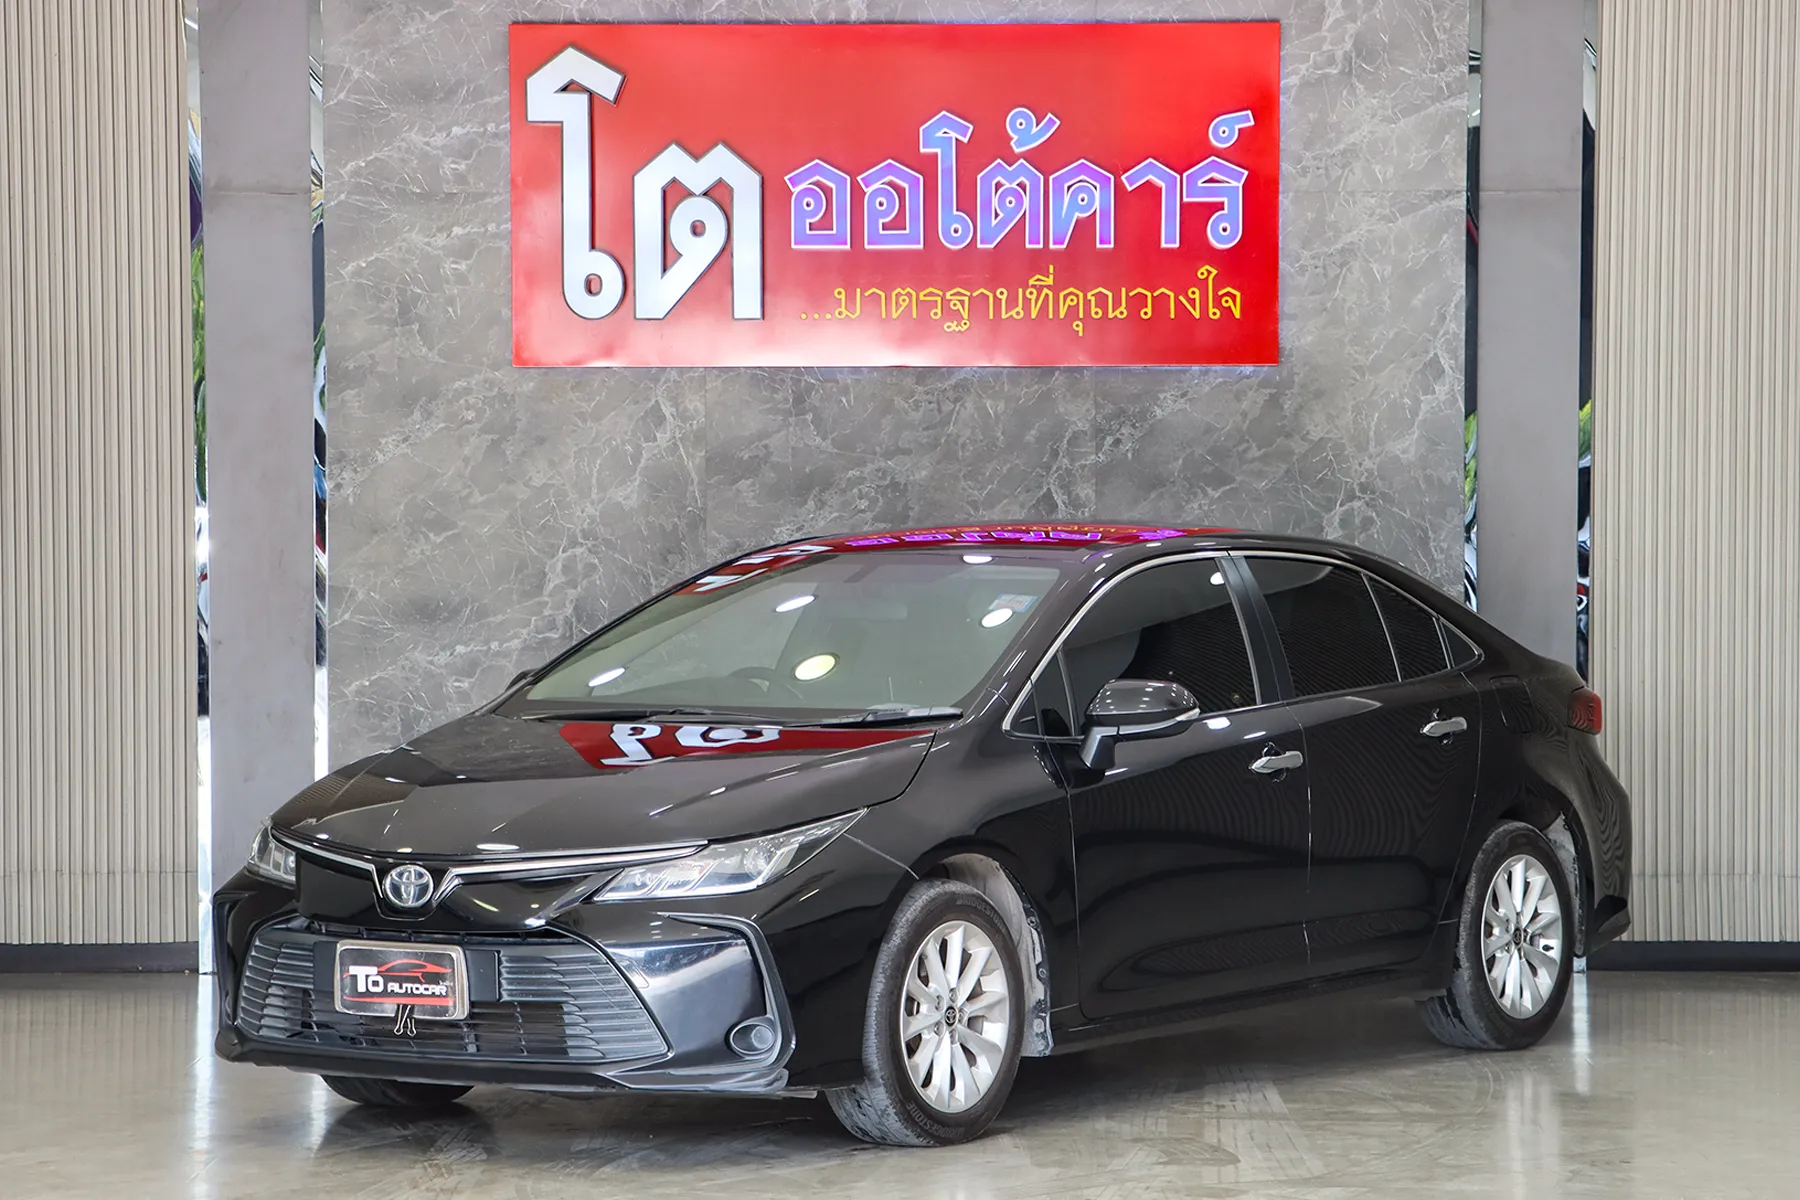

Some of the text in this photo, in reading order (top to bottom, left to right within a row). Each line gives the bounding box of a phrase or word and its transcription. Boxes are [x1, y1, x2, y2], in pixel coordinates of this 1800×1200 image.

[525, 45, 1254, 320] โต ออโต้คาร์
[387, 982, 448, 996] AUTOCAR
